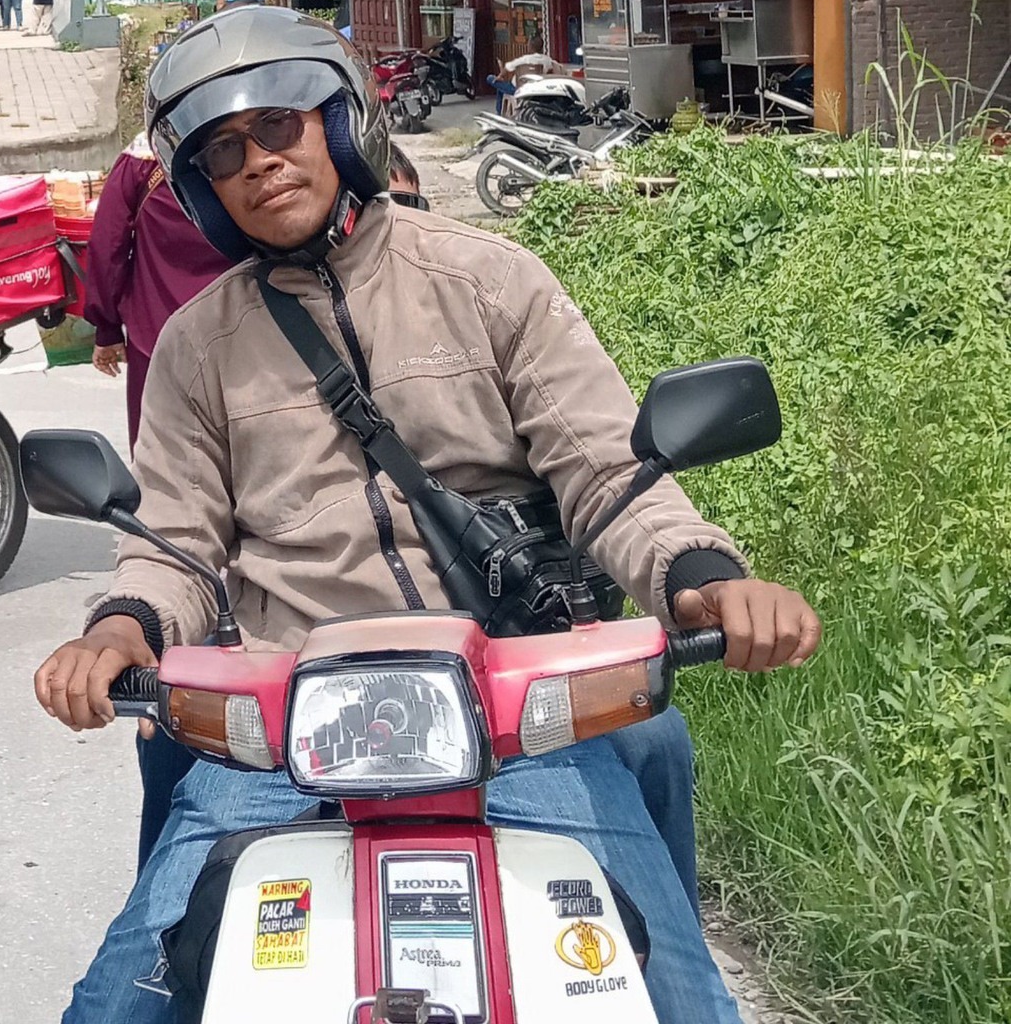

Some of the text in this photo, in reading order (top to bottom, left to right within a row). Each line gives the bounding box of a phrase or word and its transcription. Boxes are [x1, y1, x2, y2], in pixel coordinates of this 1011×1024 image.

[261, 882, 304, 896] WARNING
[393, 879, 463, 890] HONDA
[260, 901, 295, 920] PACAR
[258, 917, 305, 933] BOLEH GANTI
[256, 931, 305, 950] SAHABAT
[256, 951, 276, 965] TETAP
[278, 951, 286, 964] DI
[400, 947, 442, 964] Astrea
[565, 979, 595, 997] BODY
